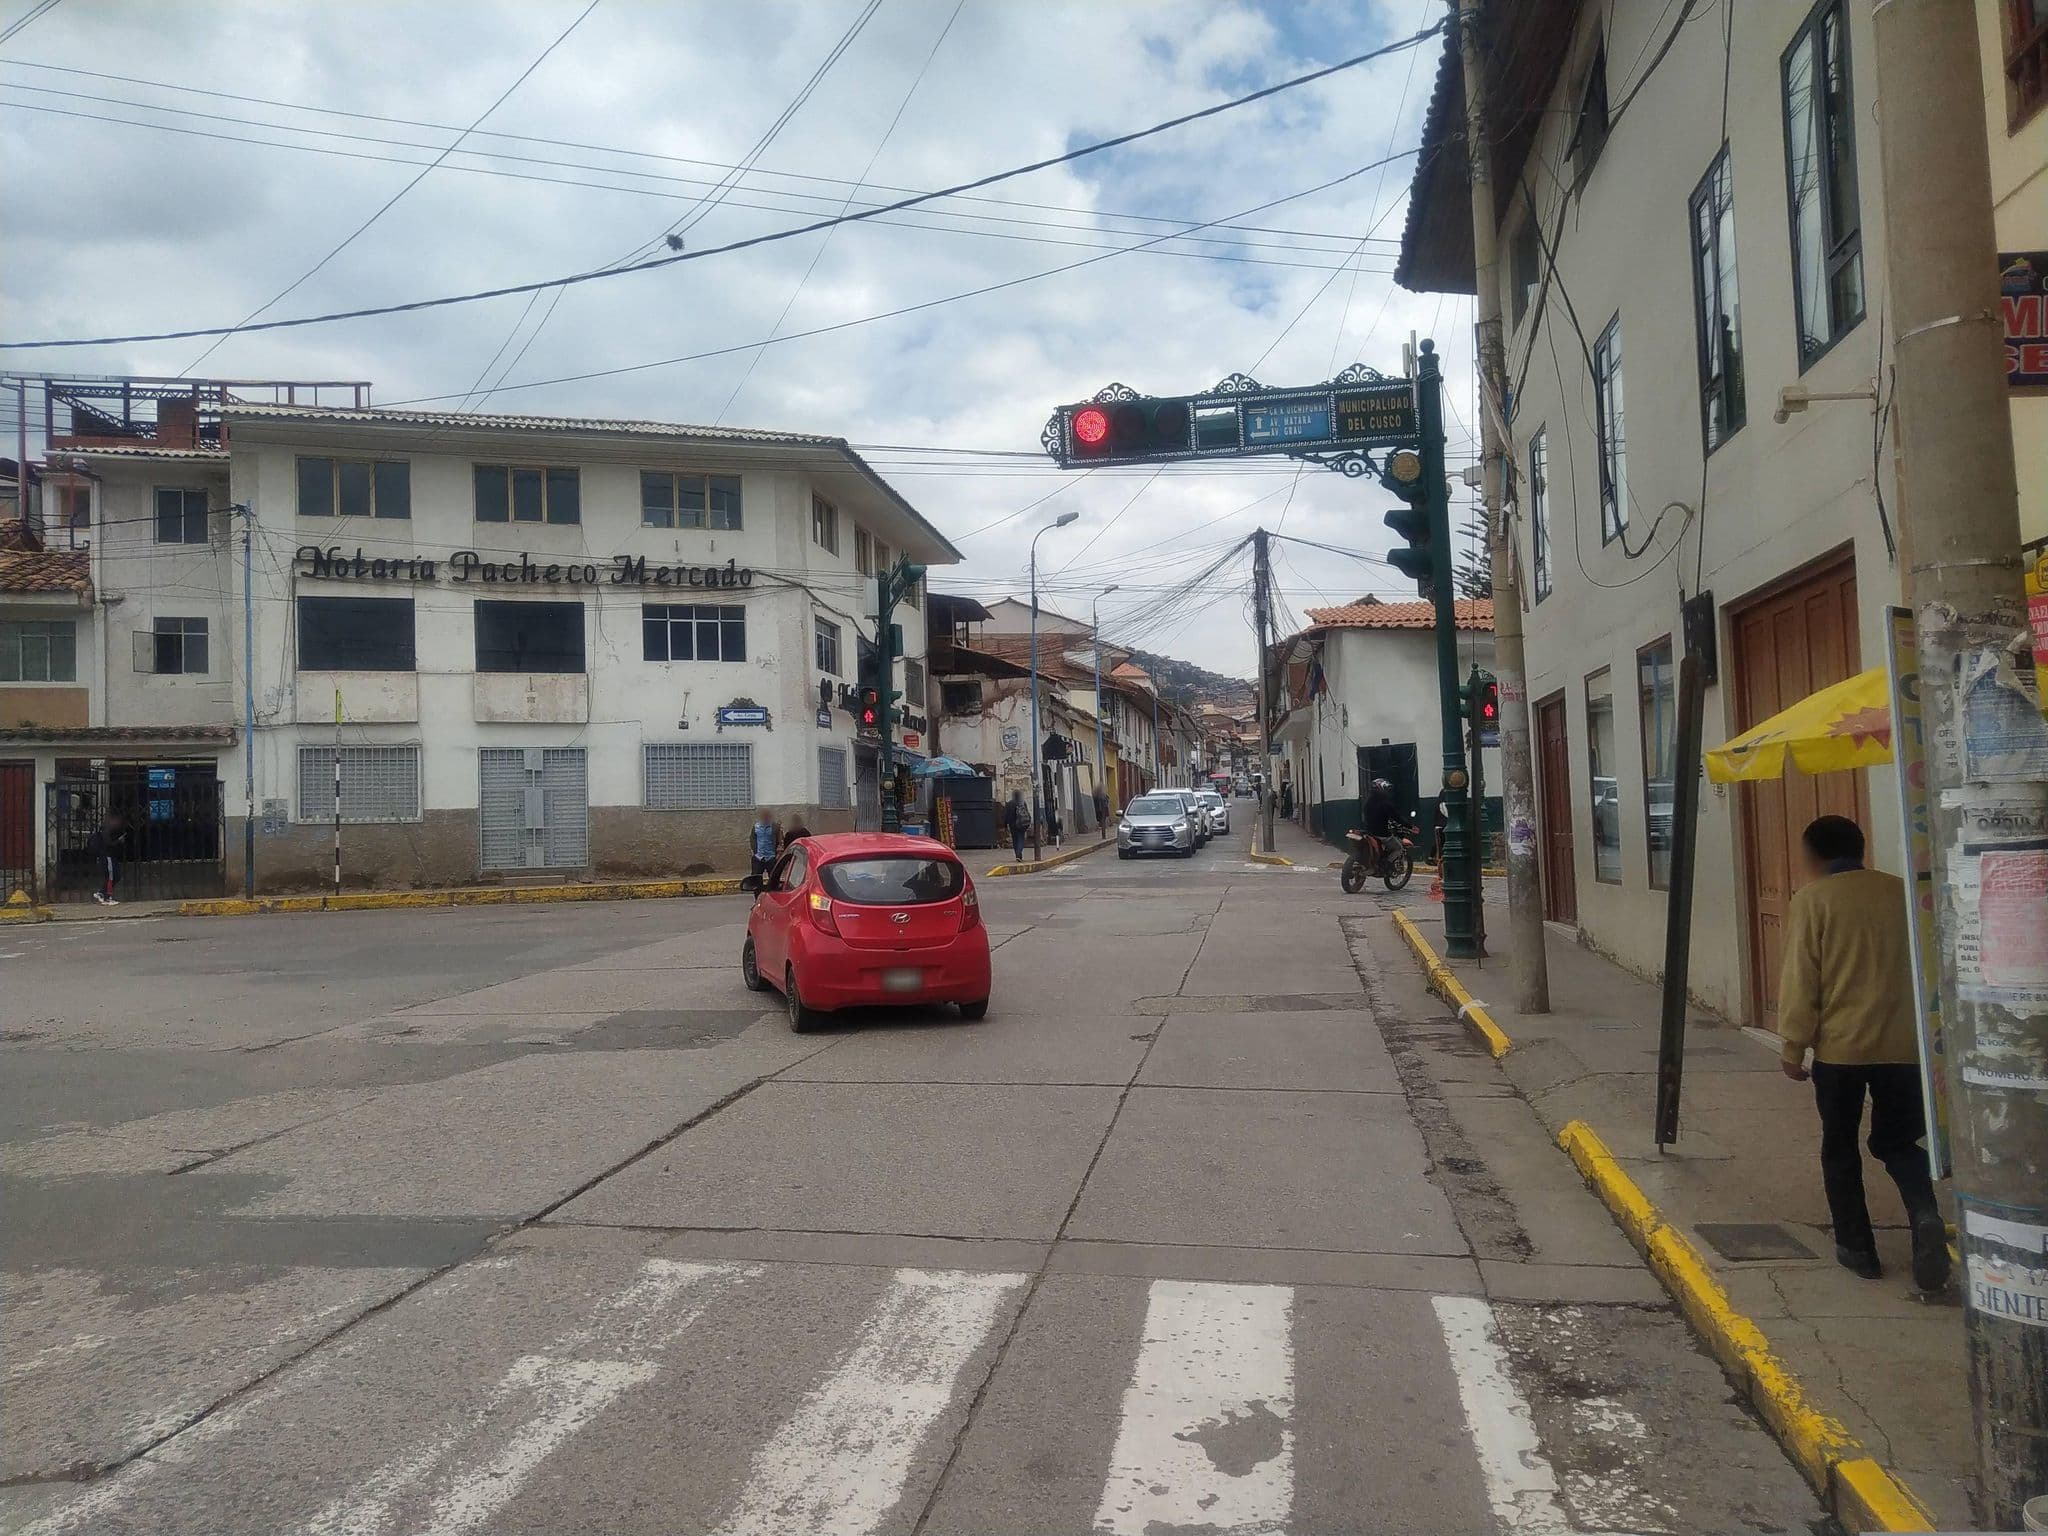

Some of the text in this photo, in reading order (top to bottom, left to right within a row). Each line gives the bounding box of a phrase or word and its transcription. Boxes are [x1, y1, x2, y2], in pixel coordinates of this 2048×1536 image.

[1338, 396, 1409, 414] MUNICIPALIDAD
[1284, 425, 1302, 436] GRAU
[1348, 415, 1401, 431] DEL CUSCO
[450, 551, 597, 585] Pacheco
[611, 554, 753, 588] Mercado
